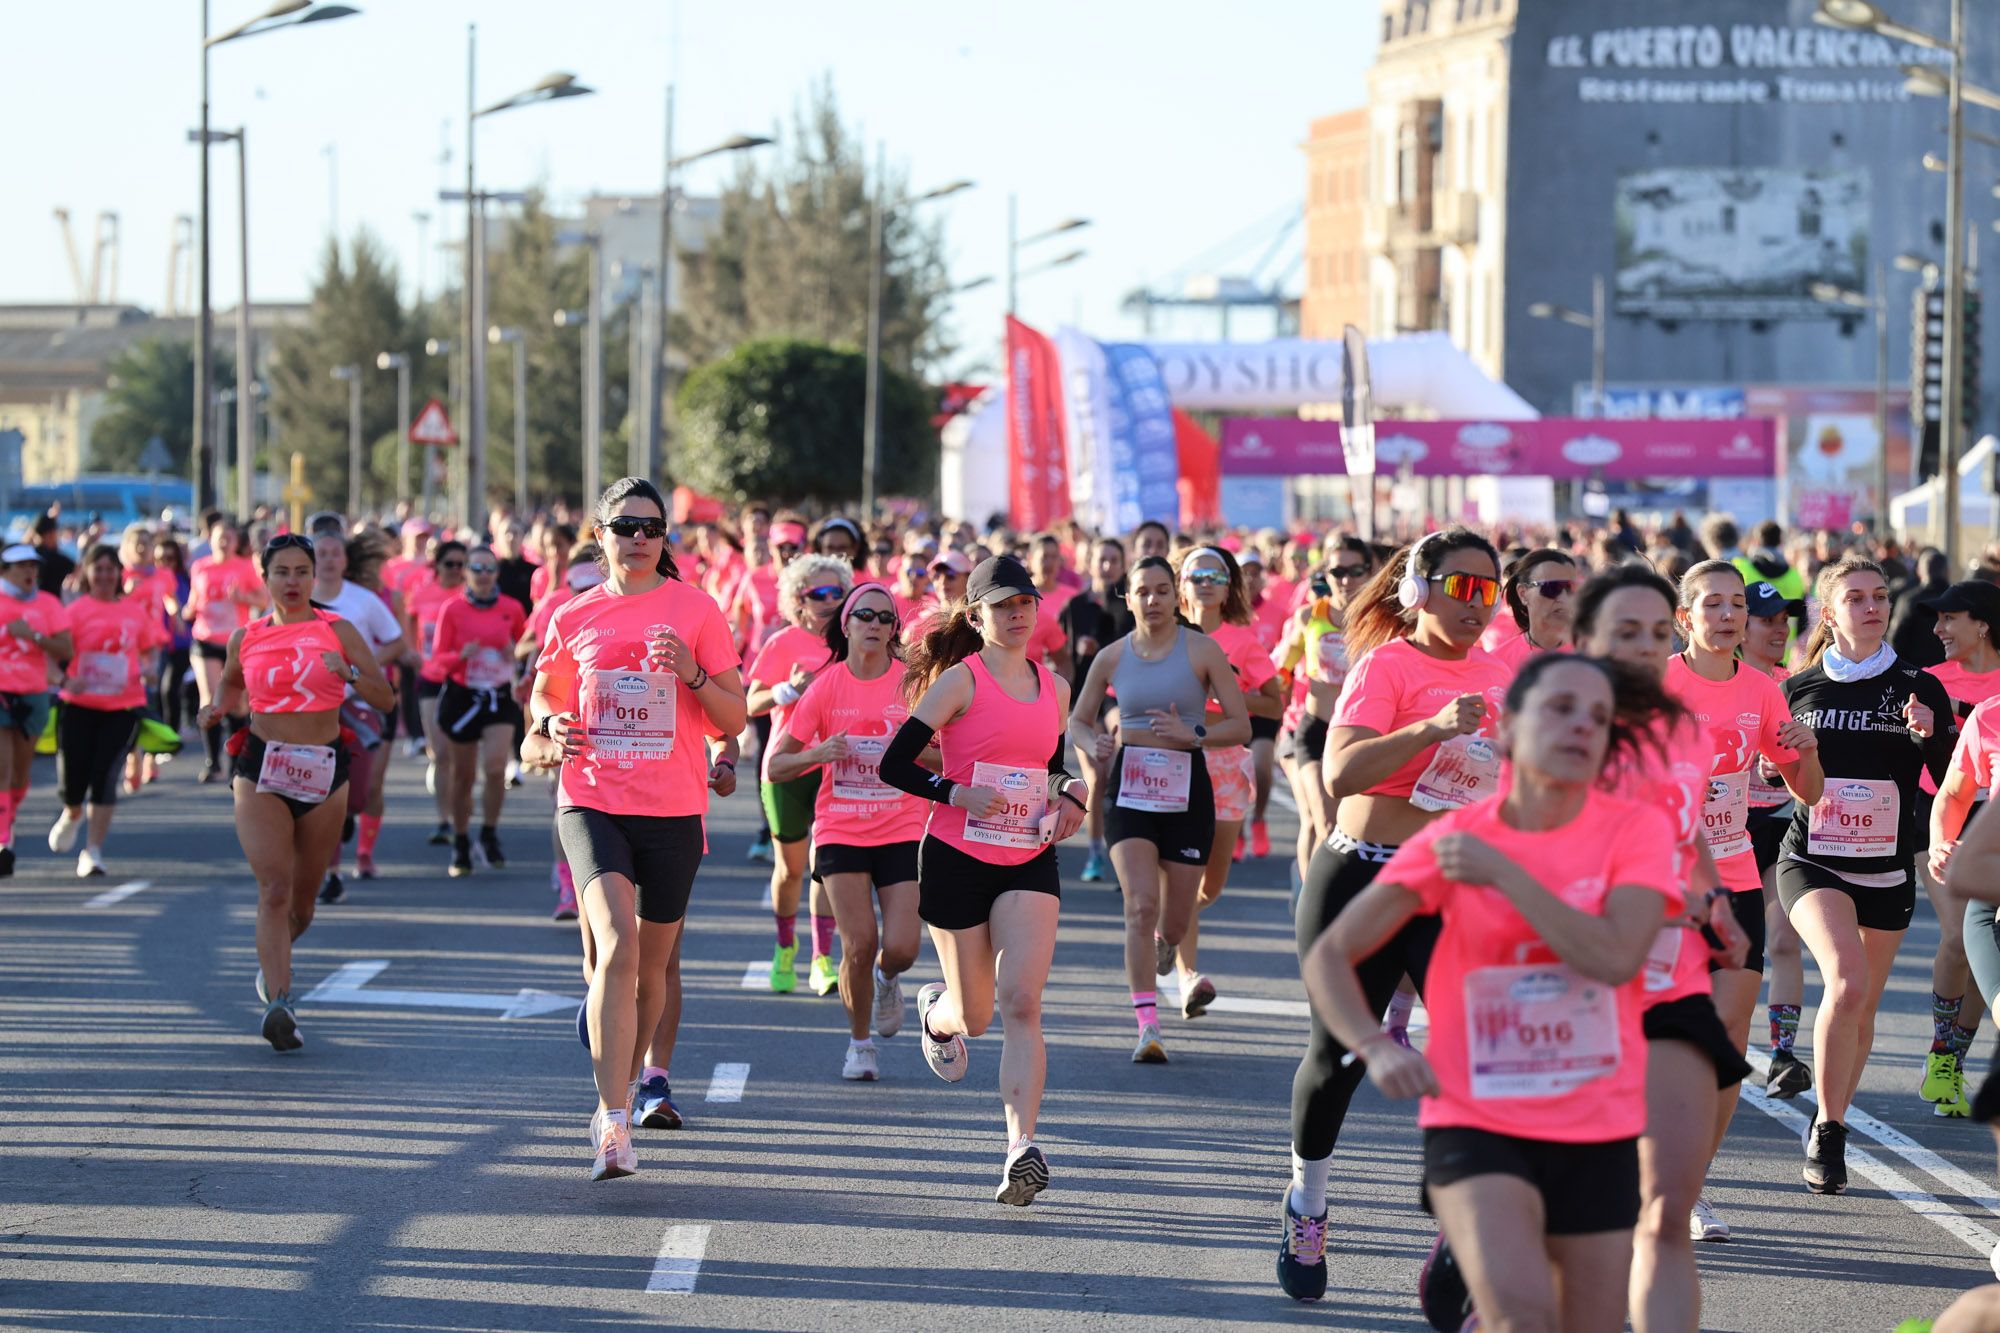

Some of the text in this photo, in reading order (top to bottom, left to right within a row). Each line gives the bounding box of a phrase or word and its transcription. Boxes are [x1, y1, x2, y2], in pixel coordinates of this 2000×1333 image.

[1591, 25, 1723, 68] PUERTO
[1579, 76, 1769, 102] Restaurante
[616, 707, 648, 720] 016
[595, 738, 622, 746] OYSHO
[618, 750, 629, 759] DE
[631, 750, 640, 759] LA
[618, 761, 633, 769] 2025
[287, 766, 312, 779] 016
[1143, 776, 1168, 788] 016
[1841, 790, 1871, 798] ASTURIANA
[829, 803, 857, 813] CARRERA
[858, 803, 868, 813] DE
[869, 803, 878, 813] LA
[1705, 811, 1732, 827] 016
[1840, 813, 1872, 827] 016
[974, 830, 1001, 840] OYSHO
[1818, 843, 1845, 851] OYSHO
[1519, 1021, 1573, 1046] 016
